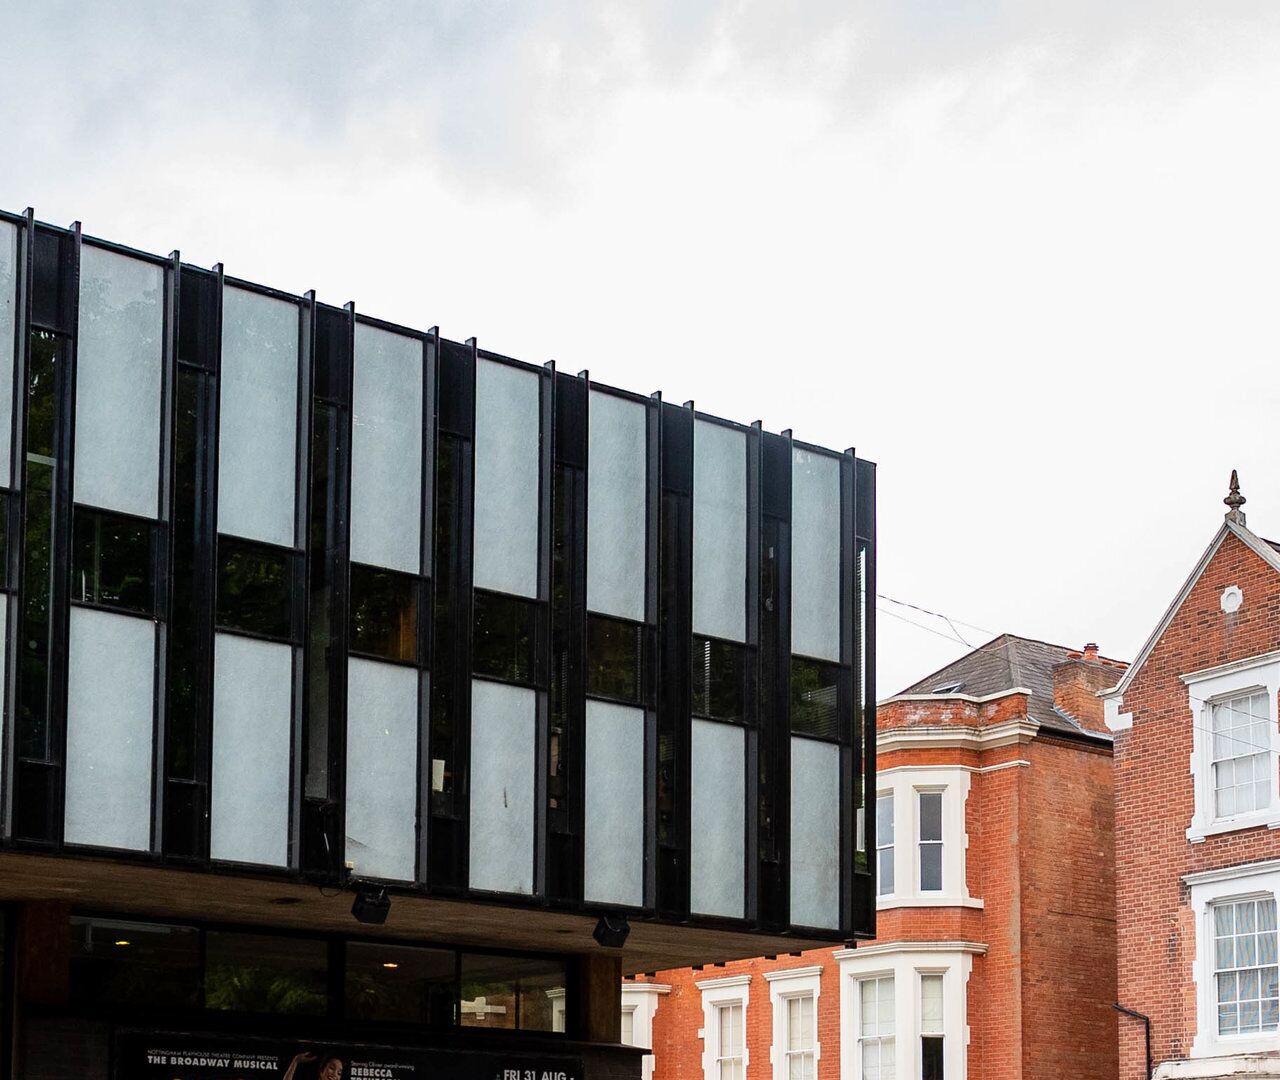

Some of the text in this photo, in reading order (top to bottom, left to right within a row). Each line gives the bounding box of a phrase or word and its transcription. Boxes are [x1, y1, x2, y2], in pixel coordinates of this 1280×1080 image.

[147, 1056, 278, 1070] THE BROADWAY MUSICAL
[351, 1067, 393, 1078] REBECCA
[503, 1069, 521, 1080] FRI
